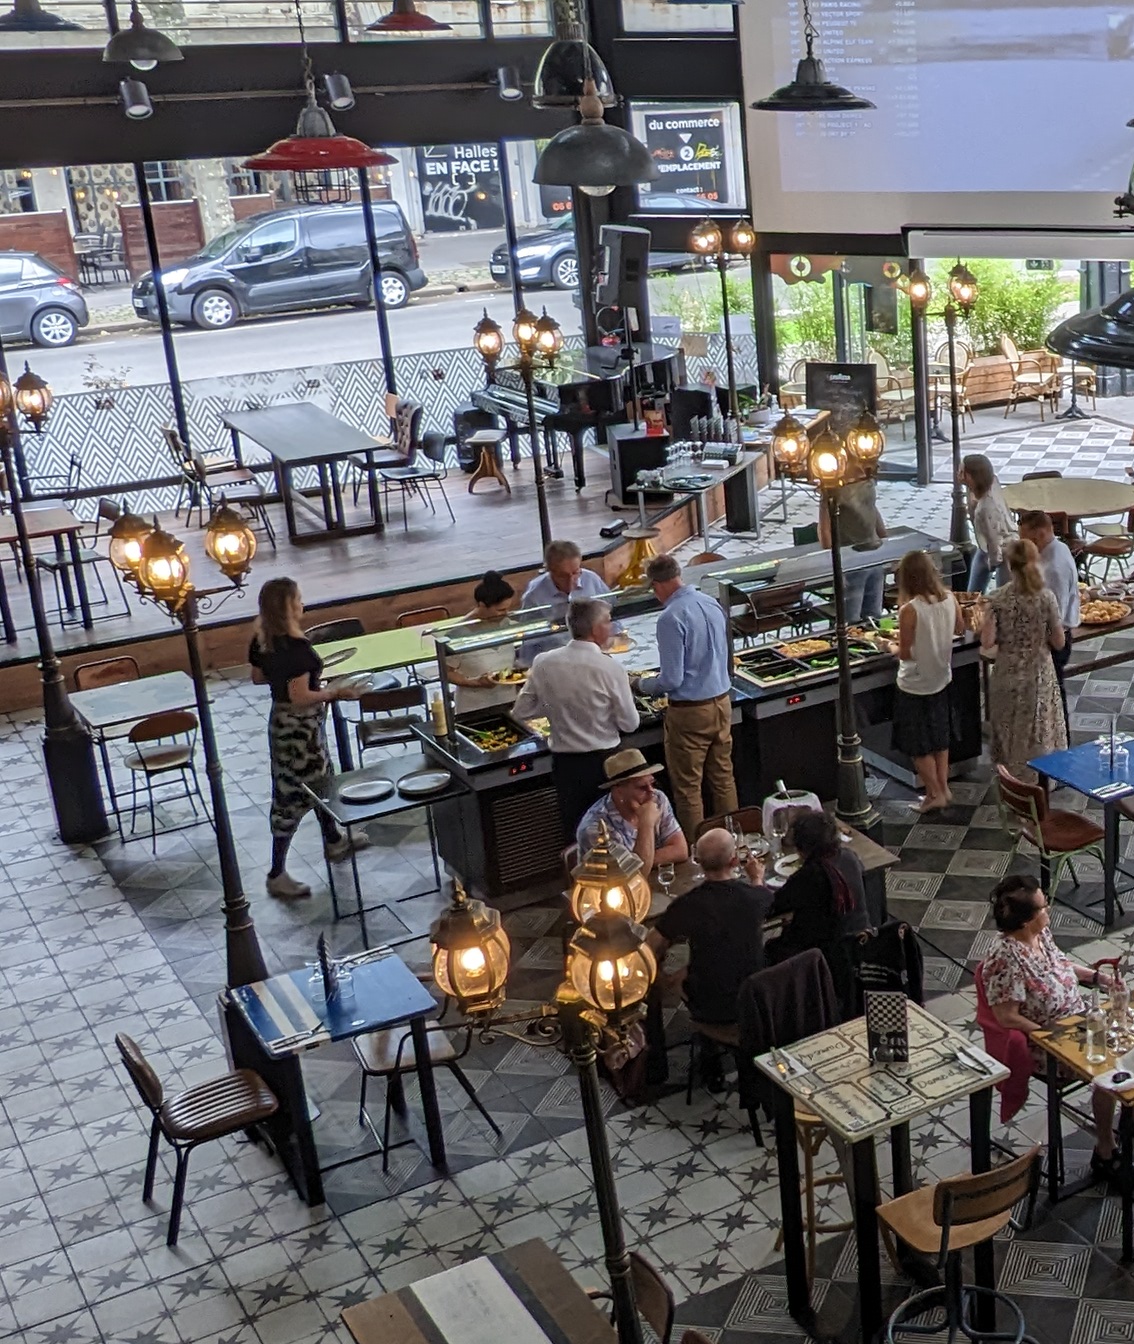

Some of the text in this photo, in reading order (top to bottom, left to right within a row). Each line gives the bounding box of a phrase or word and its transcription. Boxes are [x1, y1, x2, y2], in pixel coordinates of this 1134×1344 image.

[648, 117, 721, 130] du commerce
[454, 144, 498, 159] Halles
[425, 158, 500, 176] EN FACE !
[657, 160, 722, 174] 'EMPLACEMENT
